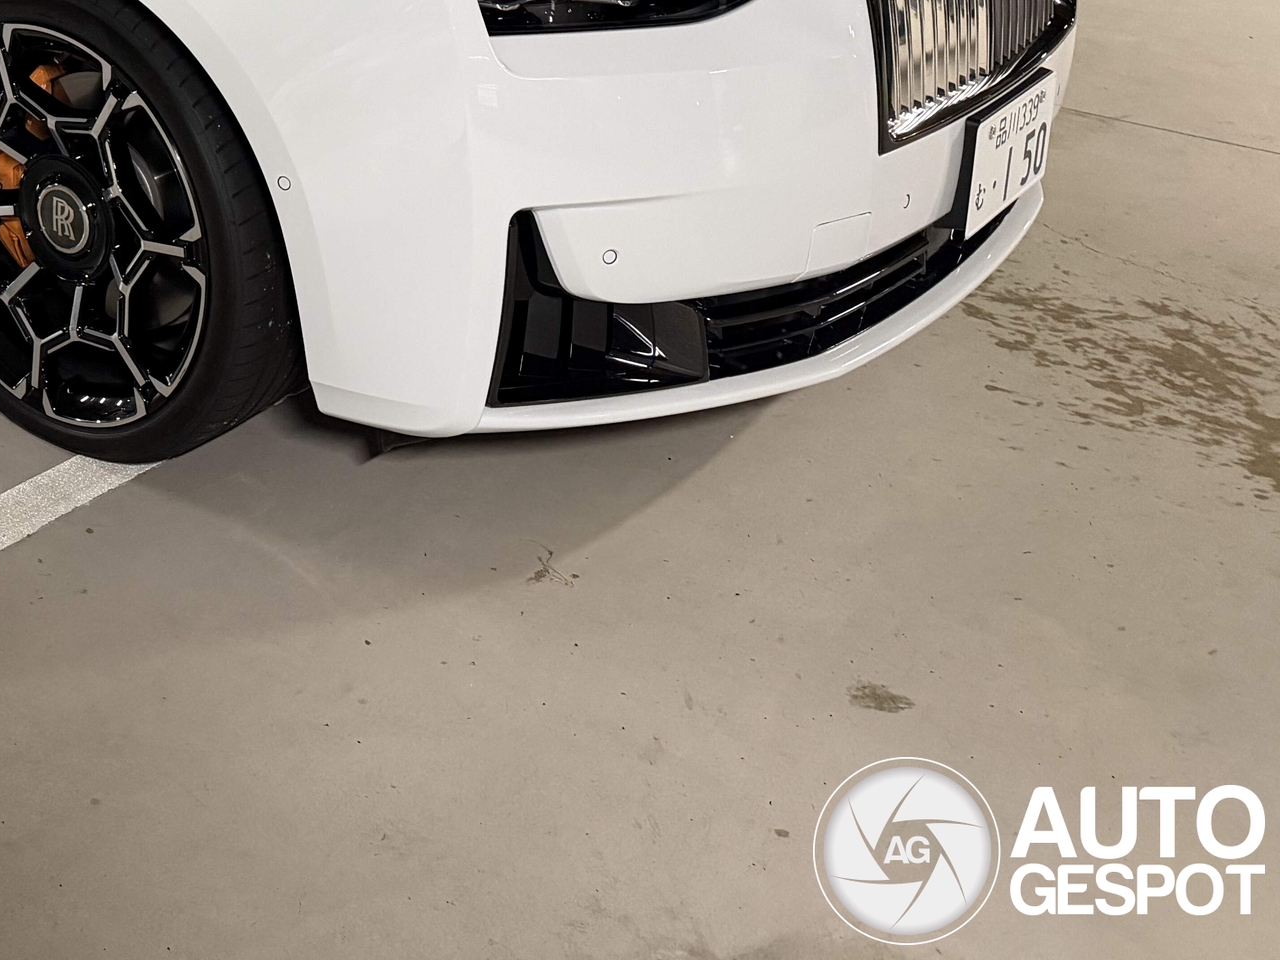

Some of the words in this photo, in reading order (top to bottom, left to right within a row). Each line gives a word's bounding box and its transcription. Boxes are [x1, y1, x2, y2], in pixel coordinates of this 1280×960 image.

[995, 107, 1020, 149] 品川
[1019, 94, 1040, 131] 339
[975, 183, 986, 211] む
